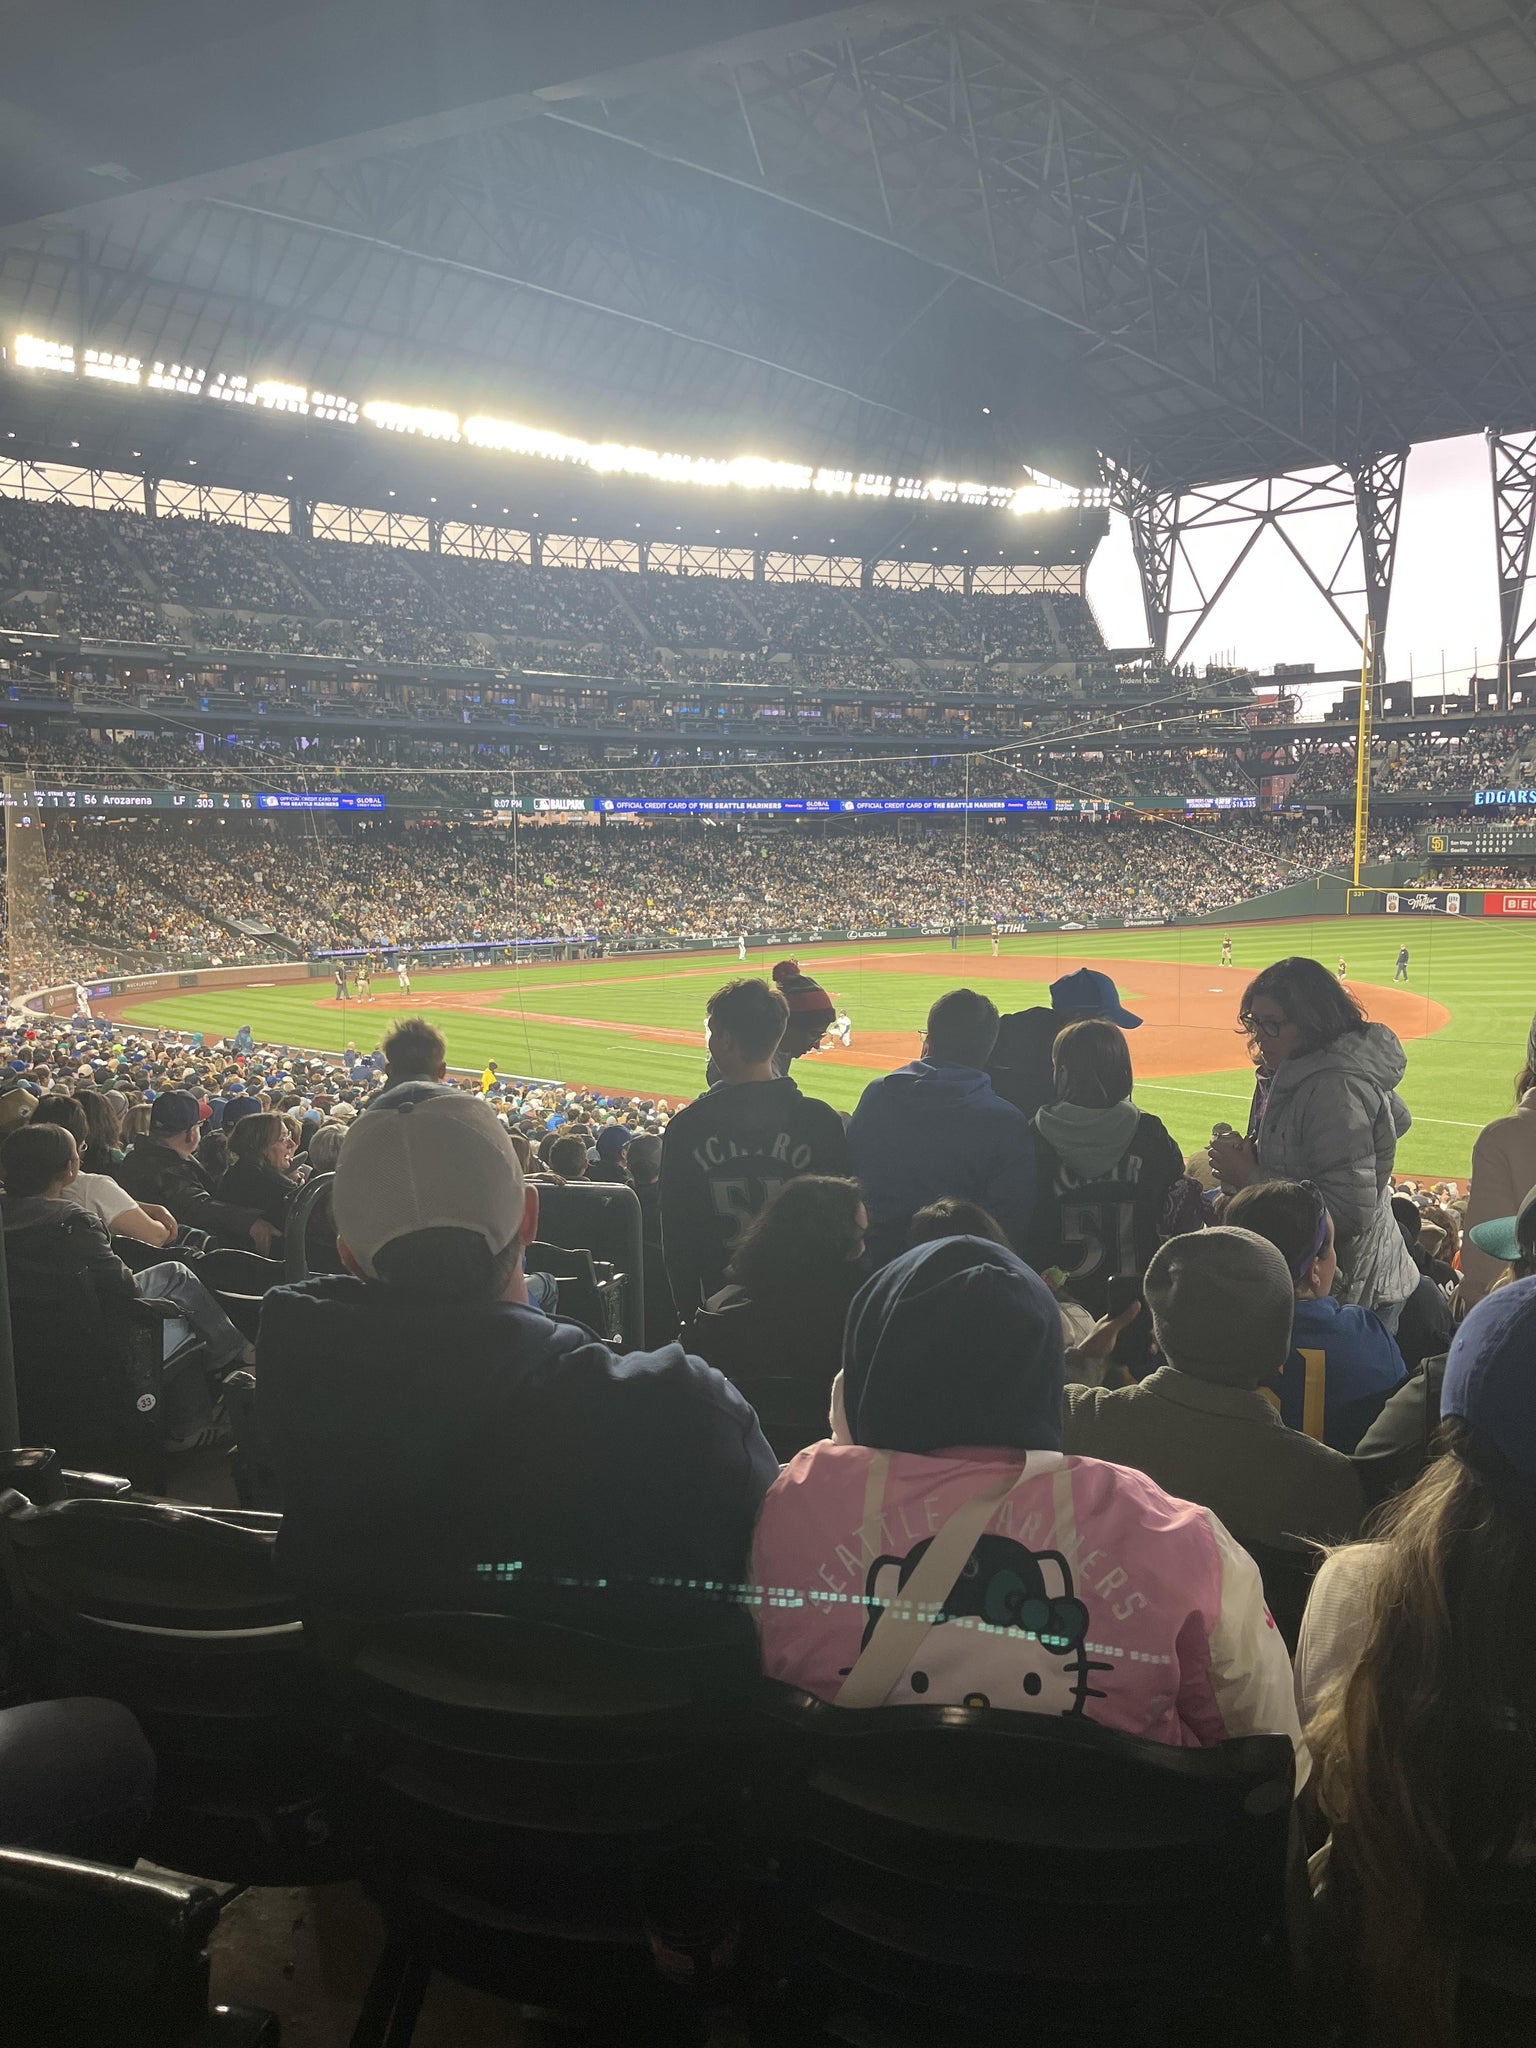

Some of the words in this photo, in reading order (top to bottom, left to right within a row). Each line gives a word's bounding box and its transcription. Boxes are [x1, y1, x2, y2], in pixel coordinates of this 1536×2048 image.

[37, 798, 44, 807] 2
[54, 798, 59, 807] 1
[69, 798, 76, 807] 2
[84, 795, 97, 805] 56
[103, 795, 153, 805] Arozarena
[173, 796, 186, 805] LF
[194, 799, 214, 808] .303
[223, 799, 230, 808] 4
[241, 799, 252, 808] 16
[494, 799, 509, 808] 8:07
[511, 799, 522, 808] PM
[551, 799, 585, 810] BALLPARK
[921, 927, 941, 935] Great
[997, 924, 1028, 934] STIHL
[692, 1132, 812, 1173] ICRO
